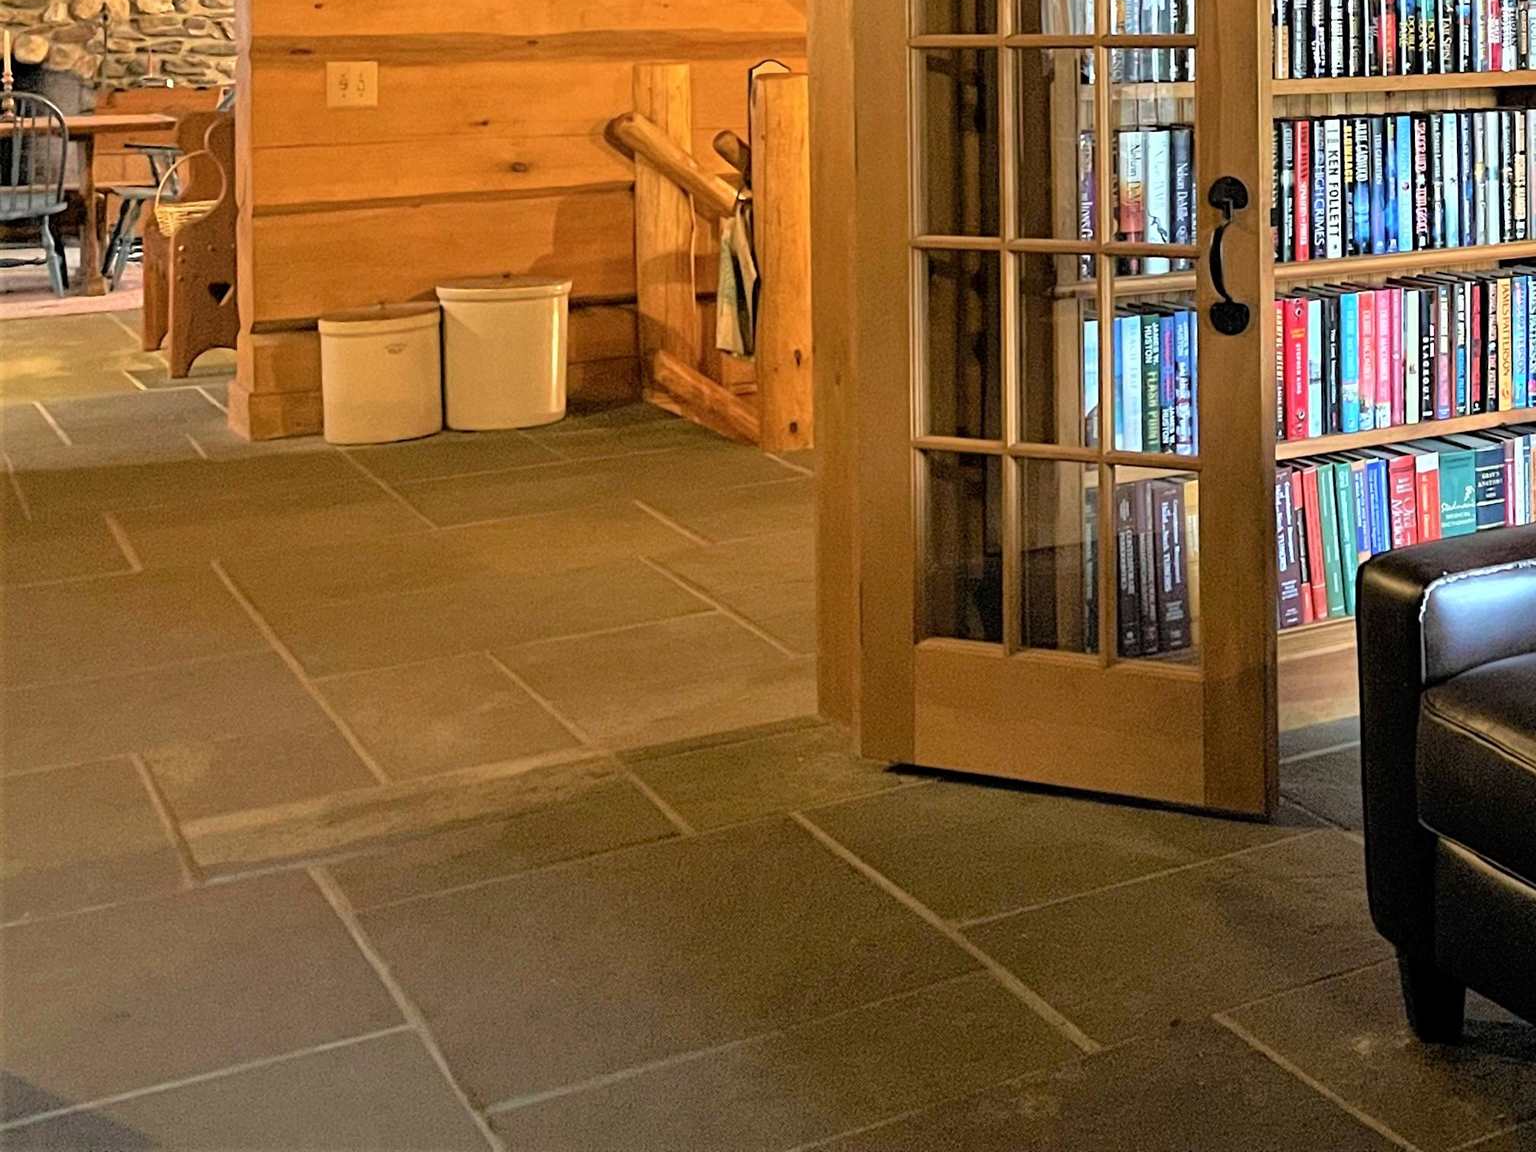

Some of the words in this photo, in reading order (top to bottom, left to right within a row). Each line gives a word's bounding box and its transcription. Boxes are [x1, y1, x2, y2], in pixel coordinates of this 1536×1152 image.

[1130, 144, 1142, 176] Nelson
[1176, 162, 1188, 190] Nelson
[1329, 149, 1340, 177] KEN
[1314, 165, 1326, 198] HIGH
[1176, 191, 1188, 221] DeMille
[1313, 198, 1326, 246] CRIMES
[1329, 181, 1340, 238] FOLLETT
[1502, 283, 1511, 315] JAMES
[1144, 325, 1154, 364] HUSTON
[1502, 315, 1511, 377] PATTERSON
[1422, 336, 1431, 402] BLACKOUT
[1147, 371, 1159, 408] FLASH
[1147, 411, 1160, 446] POINT
[1162, 408, 1171, 445] HUSTON
